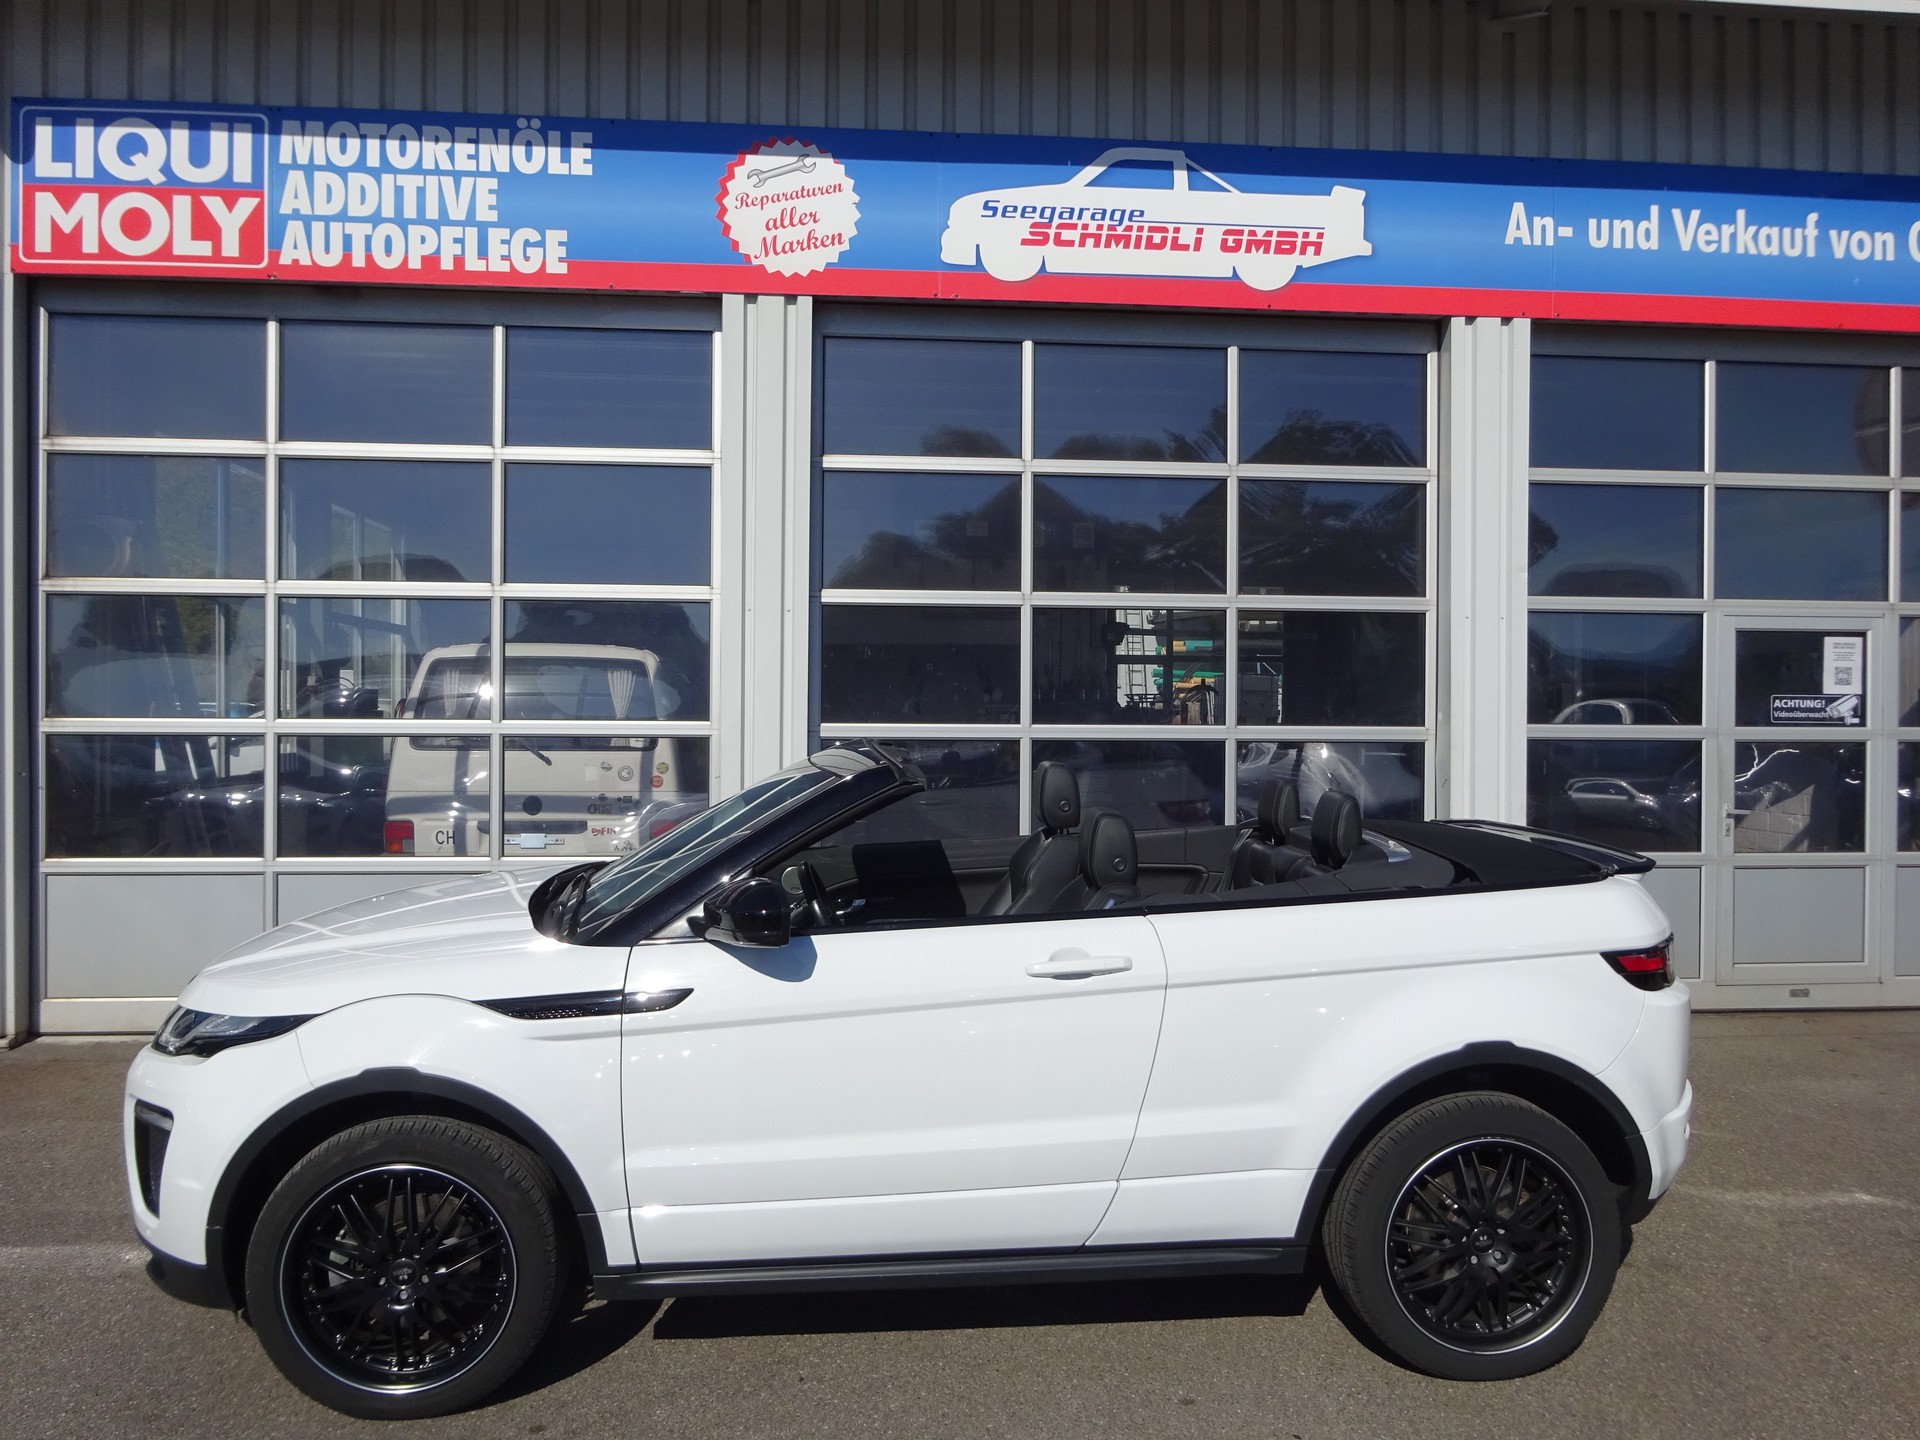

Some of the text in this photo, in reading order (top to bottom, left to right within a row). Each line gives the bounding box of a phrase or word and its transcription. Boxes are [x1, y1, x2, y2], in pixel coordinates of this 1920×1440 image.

[34, 116, 253, 186] LIQUI
[278, 117, 593, 176] MOTORENÖLE
[279, 171, 499, 222] ADDITIVE
[735, 182, 844, 210] Reparaturen
[34, 191, 262, 258] MOLY
[765, 206, 820, 232] aller
[981, 200, 1145, 227] Seegarage
[278, 220, 568, 274] AUTOPFLEGE
[754, 228, 846, 260] Marken
[1020, 223, 1325, 257] SCHMIDLI GMBH
[1504, 202, 1574, 247] An-
[1588, 204, 1660, 251] und
[1671, 208, 1820, 259] Verkauf
[1828, 229, 1896, 262] von
[1773, 699, 1826, 708] ACHTUNG!
[435, 830, 456, 845] CH
